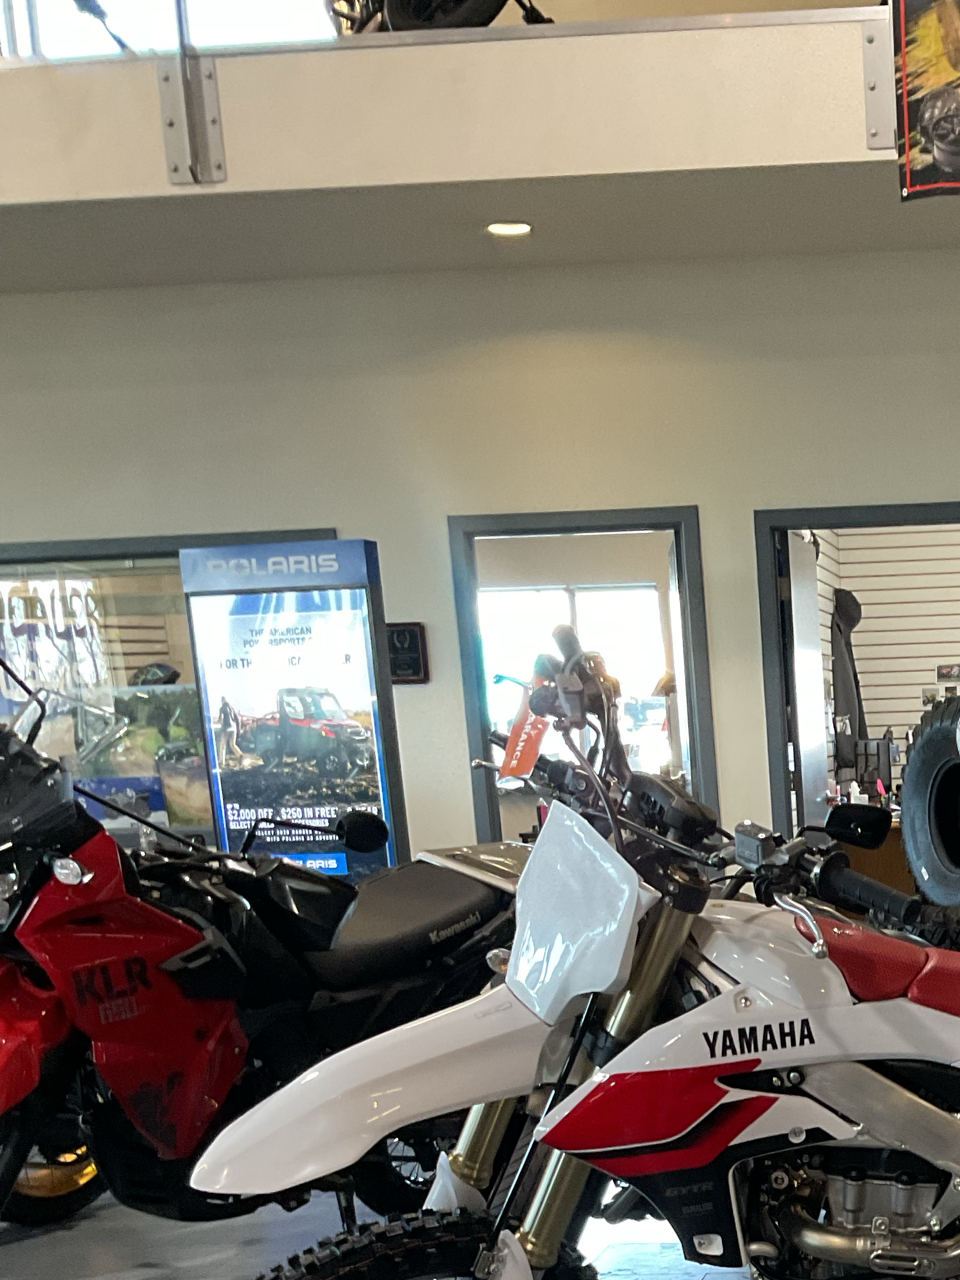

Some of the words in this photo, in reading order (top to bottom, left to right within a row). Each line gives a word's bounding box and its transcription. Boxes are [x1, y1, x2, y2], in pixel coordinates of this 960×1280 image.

[206, 553, 339, 575] POLARIS
[509, 709, 537, 769] ARANCE
[227, 808, 257, 821] $2,000
[304, 807, 313, 818] IN
[229, 820, 250, 830] SELECT
[71, 956, 153, 1006] KLR
[702, 1017, 816, 1059] YAMAHA
